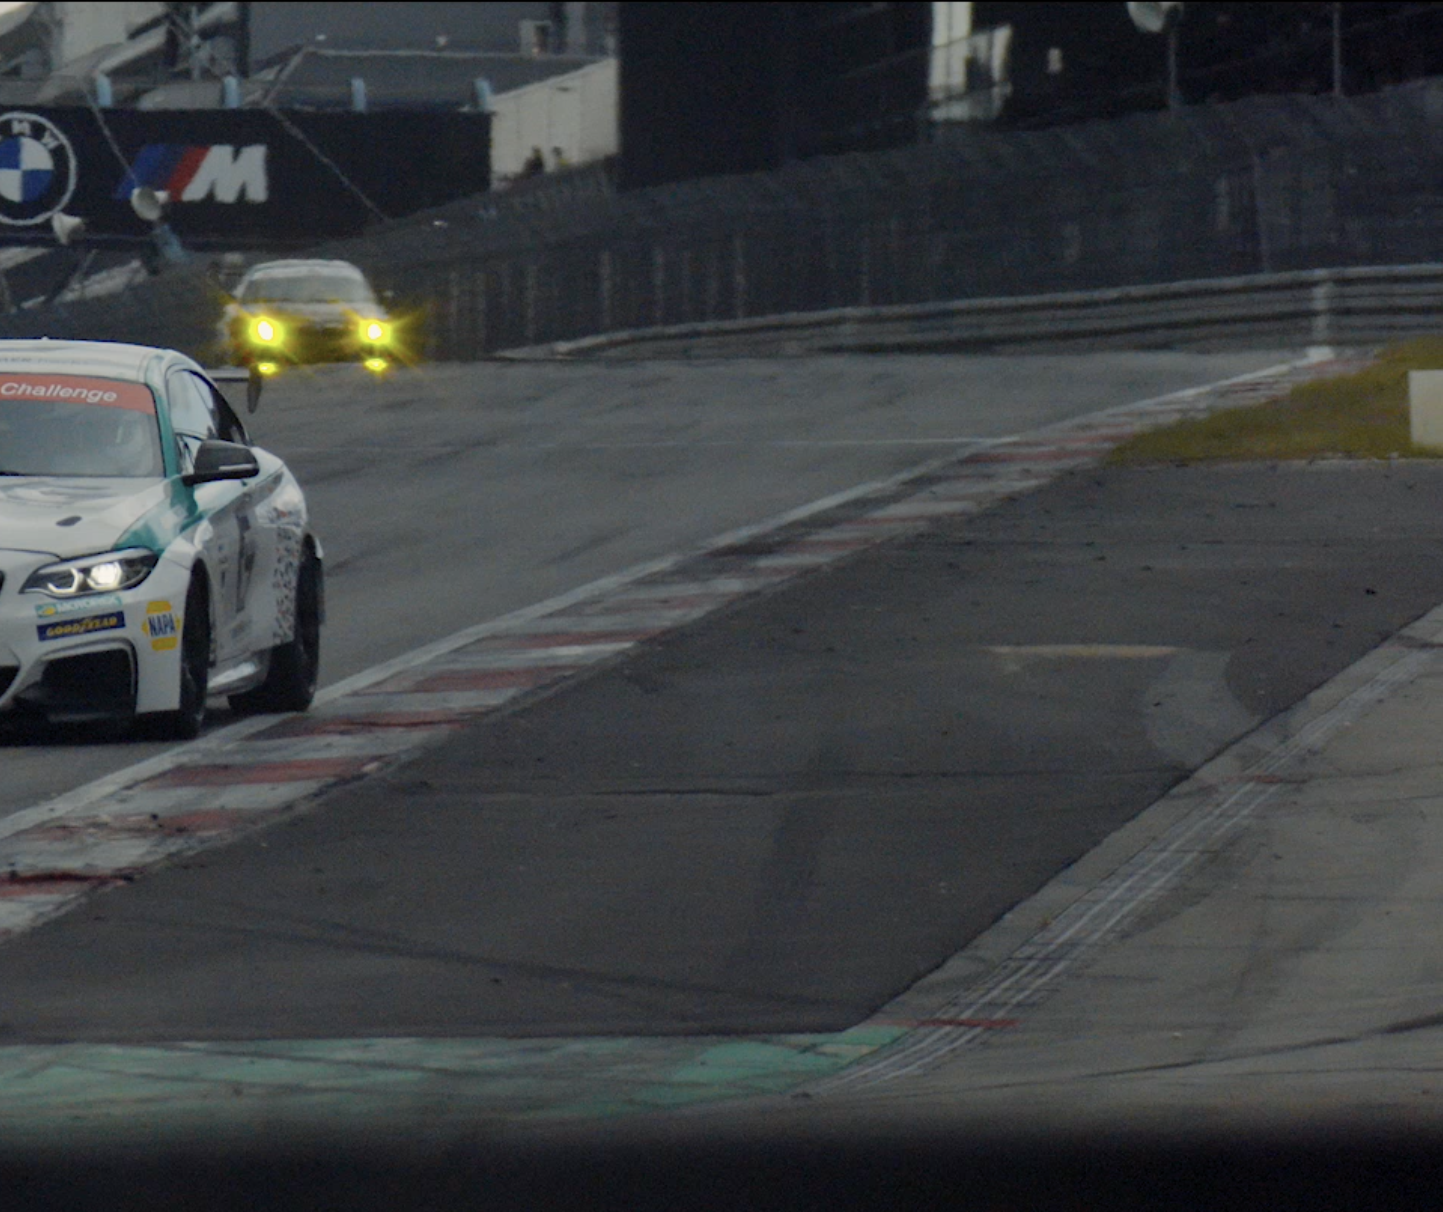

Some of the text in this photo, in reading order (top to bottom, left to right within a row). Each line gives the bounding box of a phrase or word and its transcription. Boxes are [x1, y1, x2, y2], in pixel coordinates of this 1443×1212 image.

[1, 382, 118, 403] Challenge
[45, 615, 119, 638] GOODYEAR
[148, 612, 176, 638] NAPA
